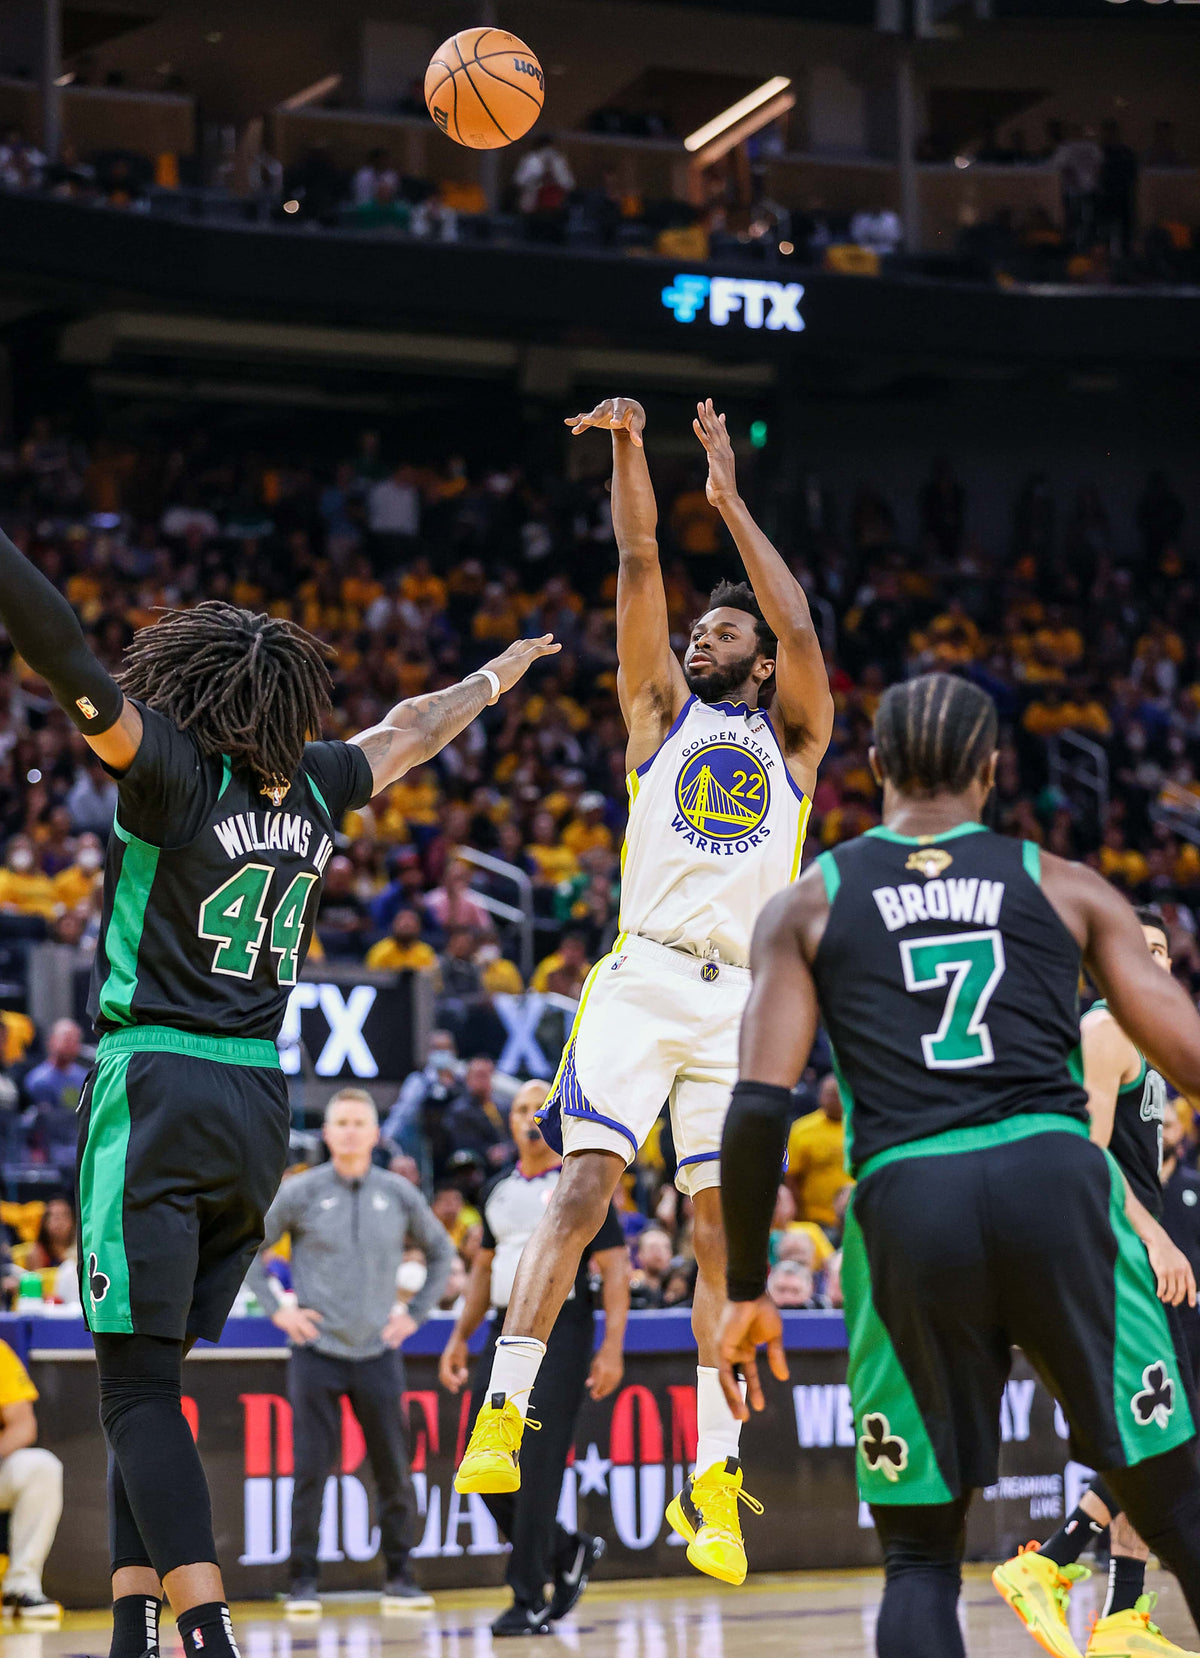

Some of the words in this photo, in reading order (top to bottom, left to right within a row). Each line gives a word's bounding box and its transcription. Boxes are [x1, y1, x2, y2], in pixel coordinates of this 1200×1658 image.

[709, 276, 806, 332] FTX
[682, 731, 737, 758] GOLDEN
[742, 736, 775, 770] STATE
[730, 770, 763, 800] 22
[671, 813, 771, 856] WARRIORS
[198, 863, 319, 986] 44
[872, 877, 1005, 932] BROWN
[899, 929, 1006, 1070] 7
